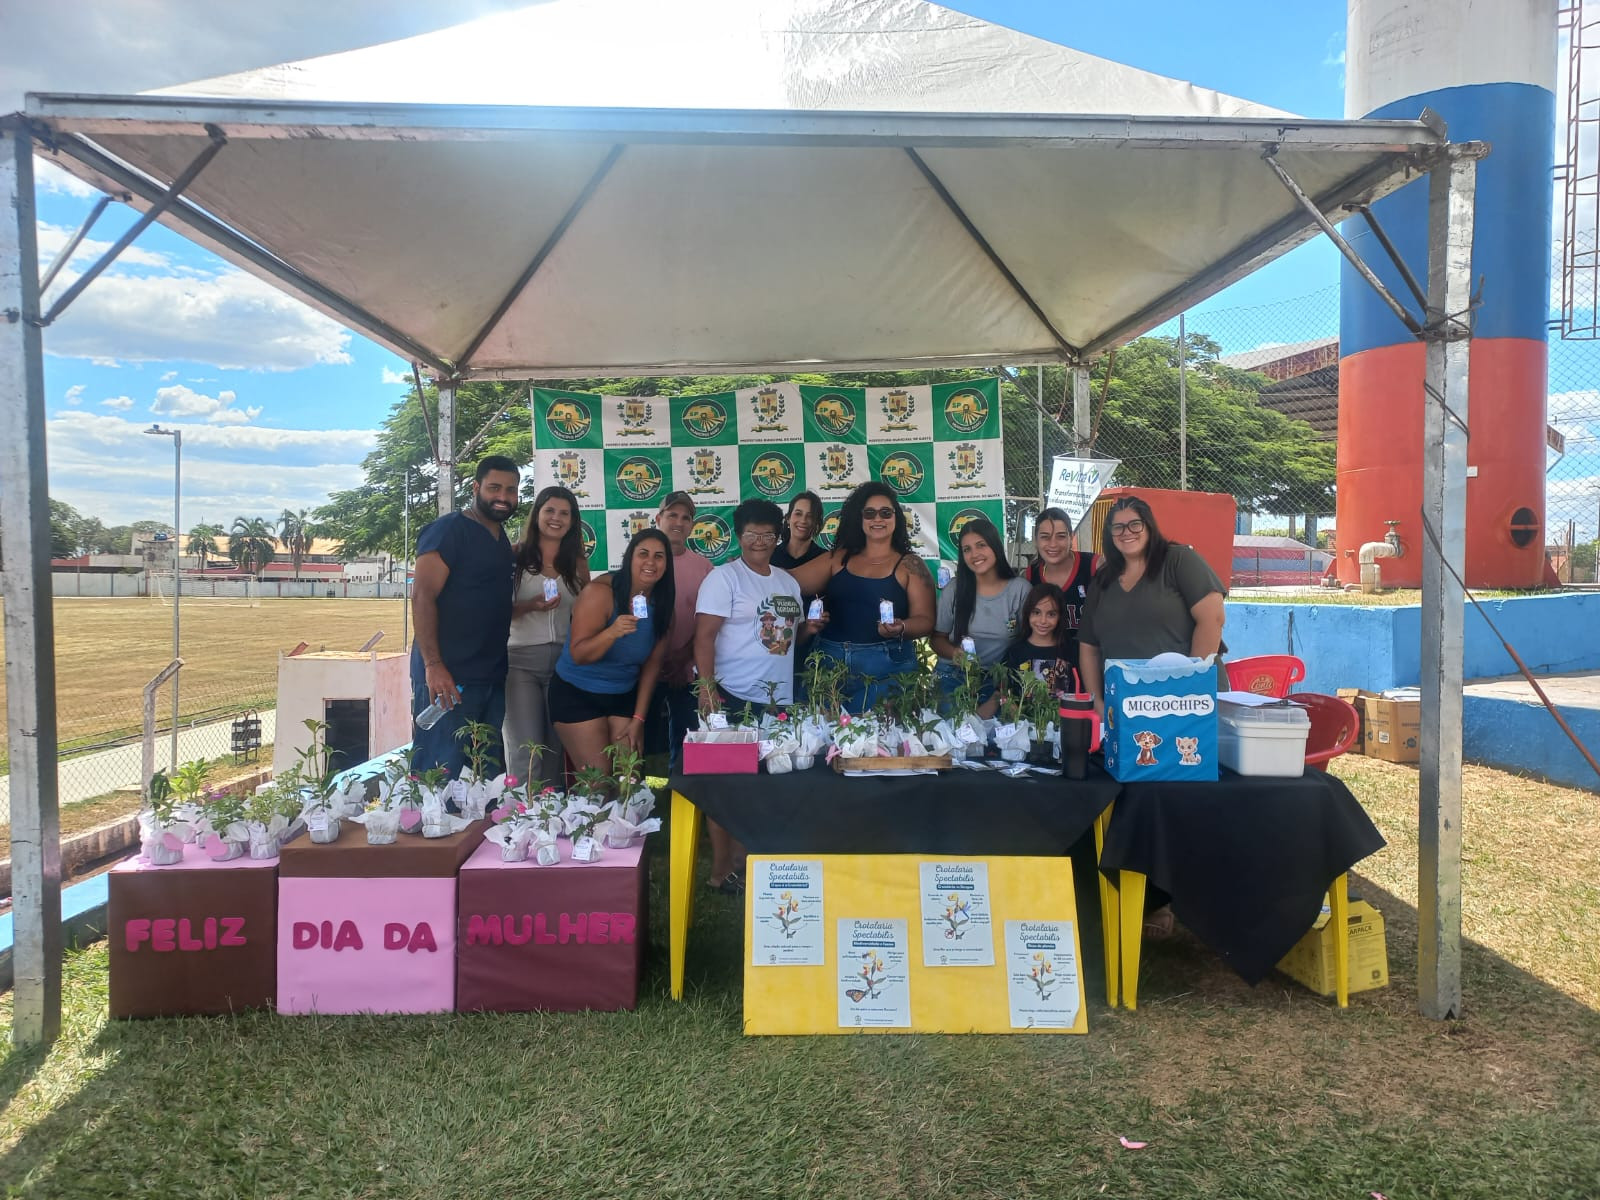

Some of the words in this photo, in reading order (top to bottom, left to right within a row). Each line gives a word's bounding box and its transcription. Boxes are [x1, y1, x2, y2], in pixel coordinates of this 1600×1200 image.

[1128, 699, 1210, 713] MICROCHIPS
[126, 916, 247, 952] FELIZ
[292, 919, 363, 951] DIA
[383, 921, 438, 953] DA
[465, 912, 637, 946] MULHER
[1348, 925, 1373, 936] ARPACK
